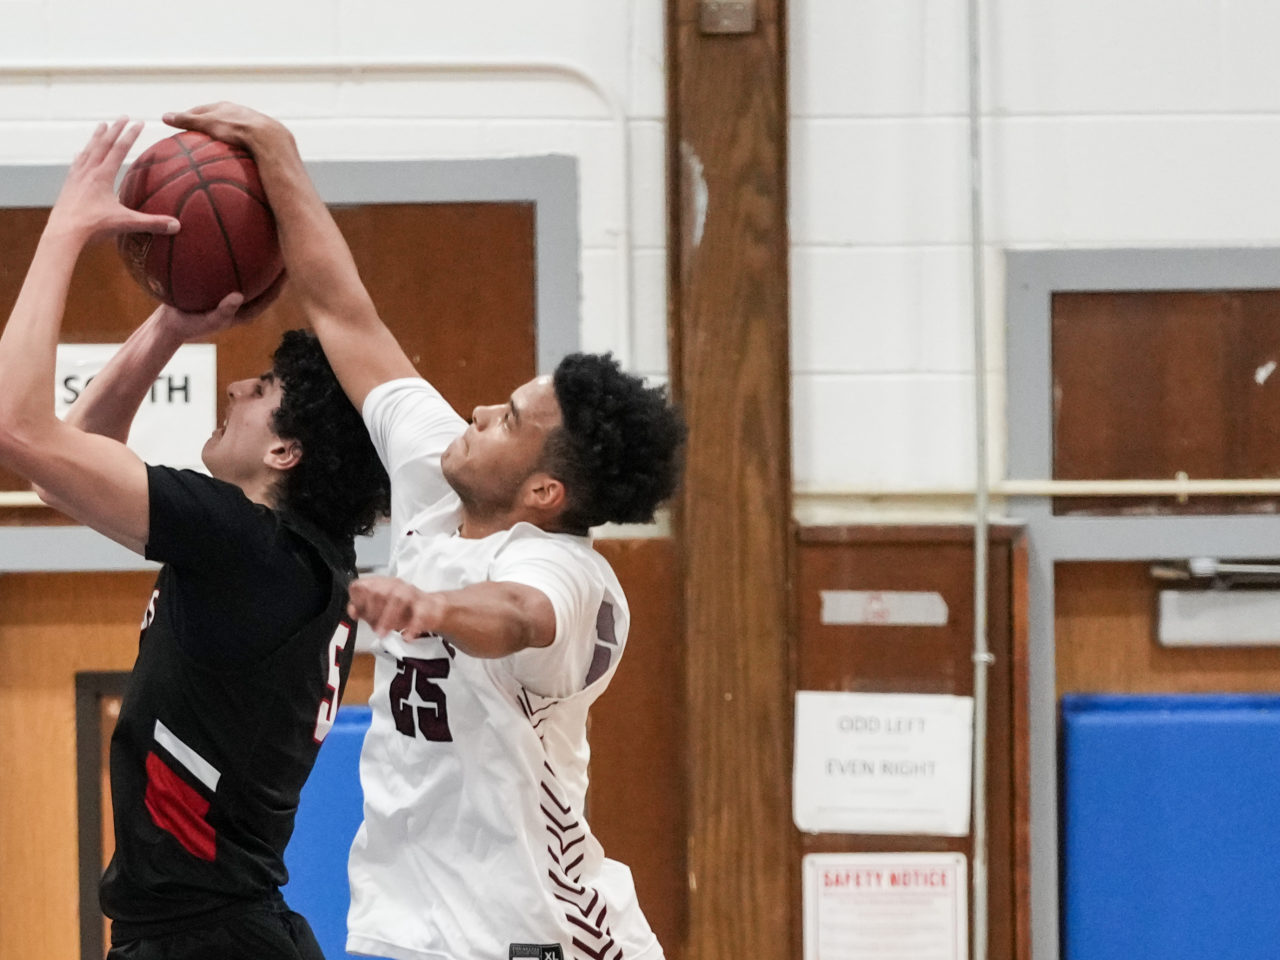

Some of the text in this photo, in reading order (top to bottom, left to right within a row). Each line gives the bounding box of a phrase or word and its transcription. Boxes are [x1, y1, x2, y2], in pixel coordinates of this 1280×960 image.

[63, 375, 190, 404] STH
[389, 656, 454, 743] 25
[838, 716, 926, 734] ODD LEFT
[825, 759, 937, 777] EVEN RIGHT
[824, 871, 948, 888] SAFETY NOTICE
